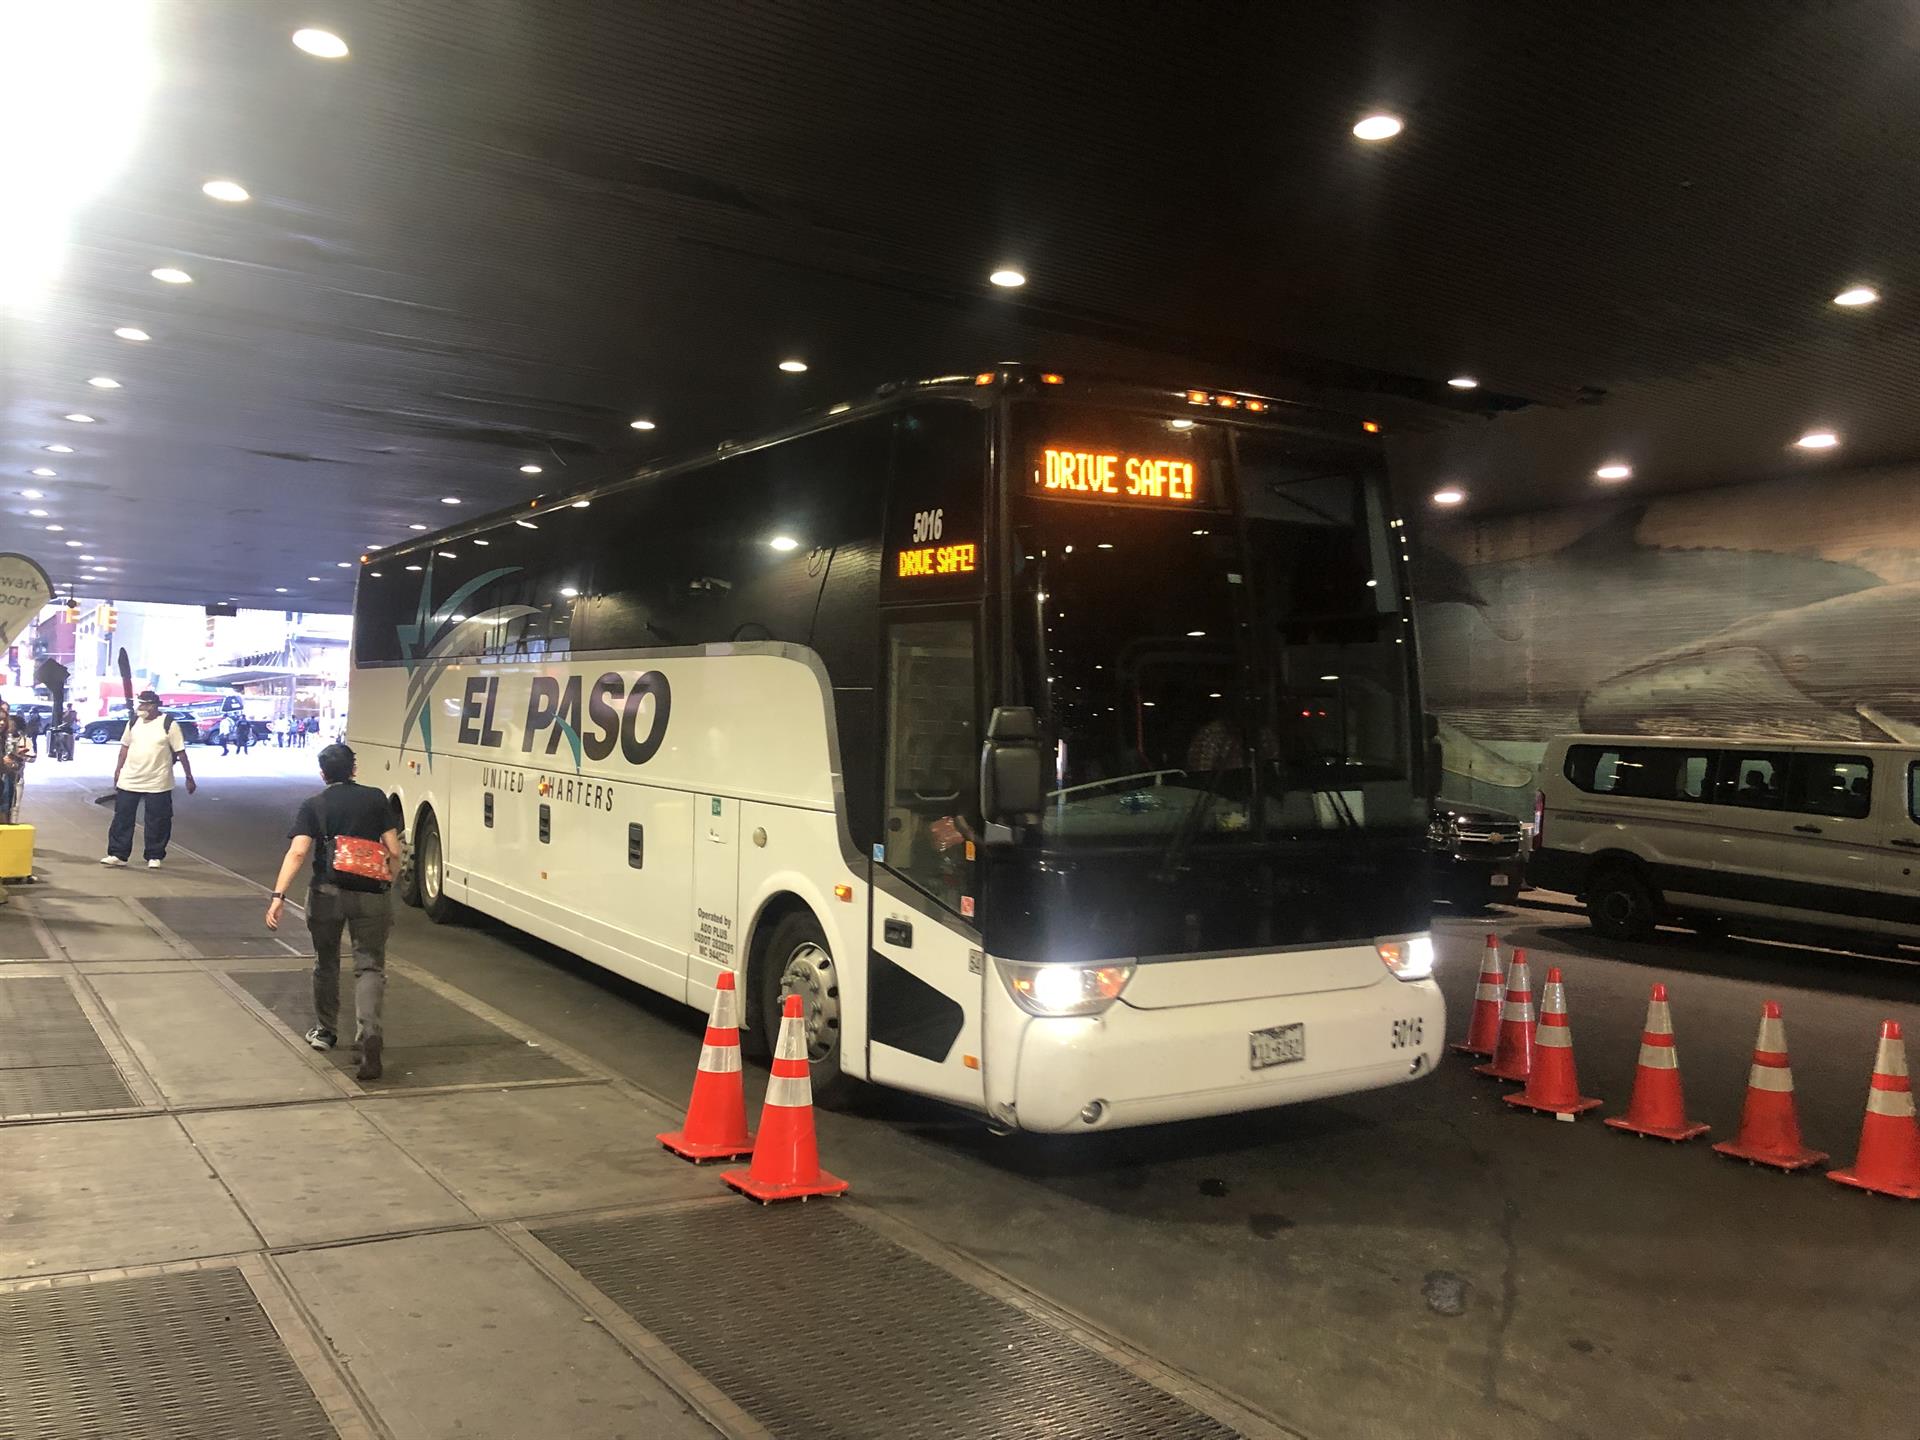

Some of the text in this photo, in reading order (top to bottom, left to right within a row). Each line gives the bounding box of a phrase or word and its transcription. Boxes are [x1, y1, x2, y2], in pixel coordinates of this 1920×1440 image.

[1044, 449, 1194, 500] DRIVE SAFE!
[912, 508, 944, 543] 5016
[899, 544, 975, 577] DRIVE SAFE!
[458, 670, 672, 765] EL PASO
[482, 767, 614, 812] UNITED CHARTERS
[697, 907, 732, 930] Operated by
[713, 926, 728, 940] PLUS
[693, 931, 711, 946] USDOT
[1391, 1017, 1424, 1049] 5016
